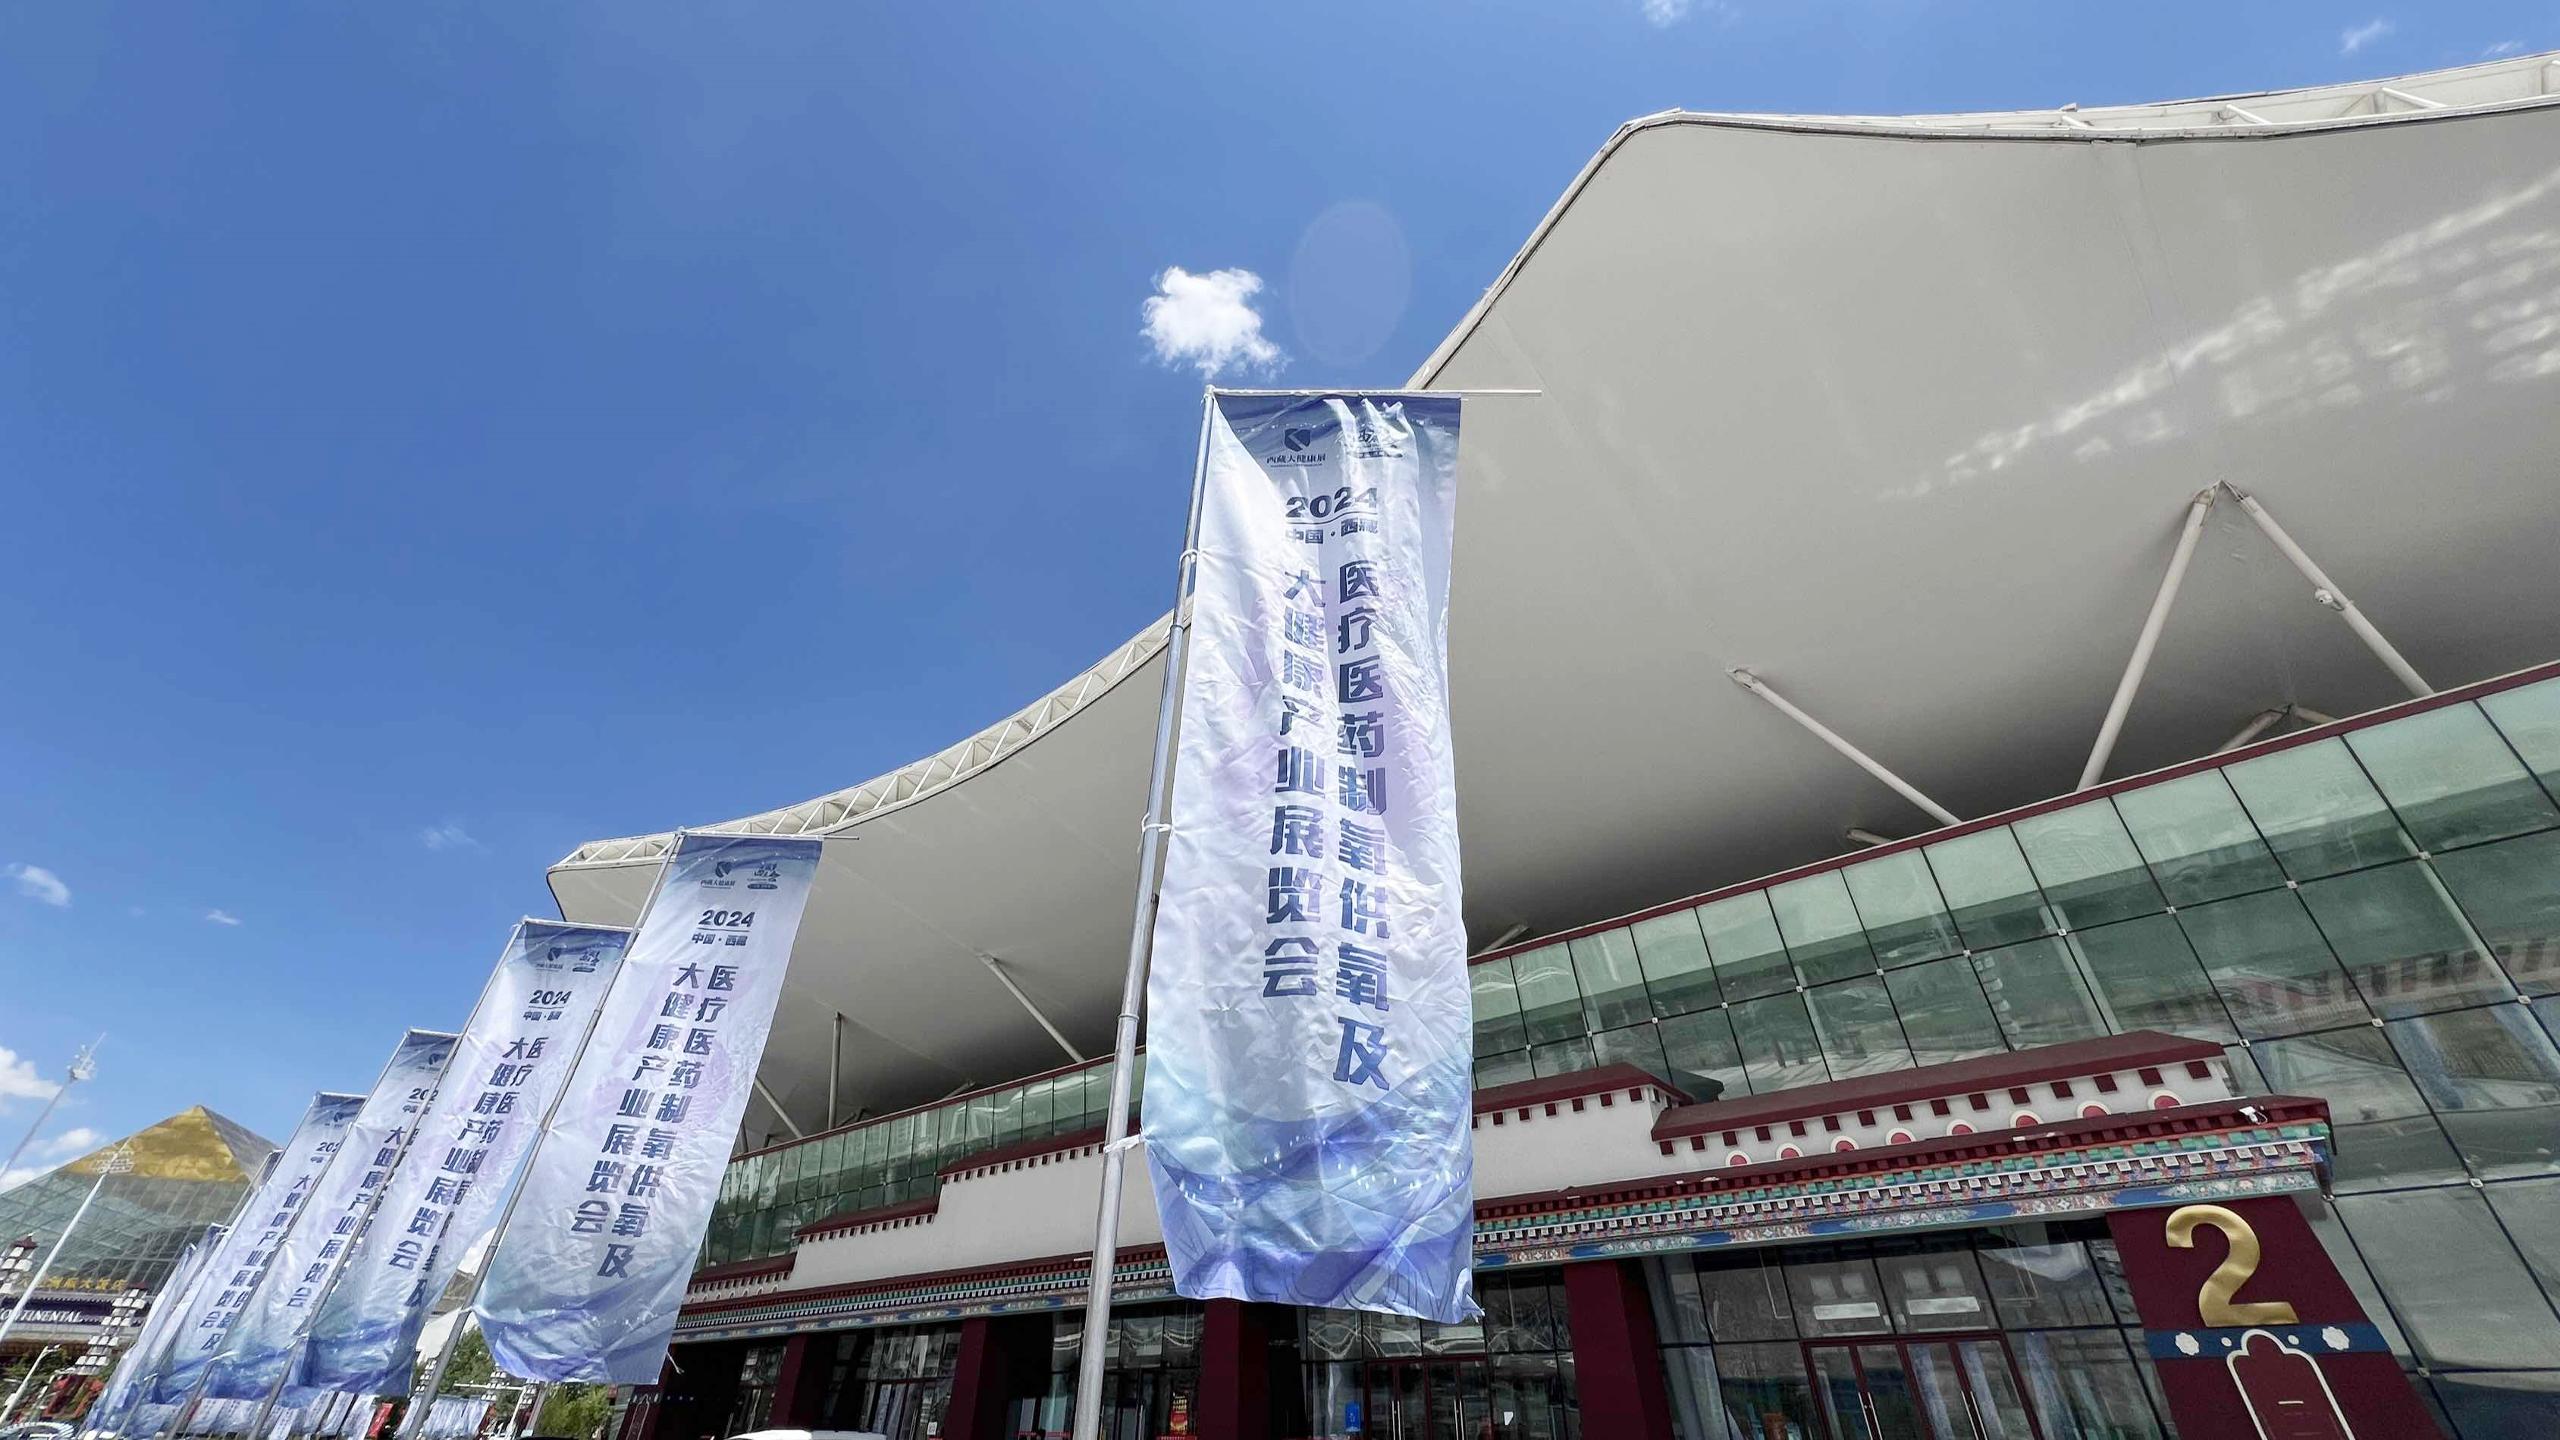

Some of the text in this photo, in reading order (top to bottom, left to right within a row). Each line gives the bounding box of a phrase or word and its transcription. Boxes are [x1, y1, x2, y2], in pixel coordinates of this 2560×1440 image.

[1286, 487, 1378, 518] 2024
[1263, 569, 1327, 997] 大健康产业展览会
[1333, 559, 1390, 1091] 医疗医药制氧供氧及
[692, 932, 748, 947] 中国·西藏
[698, 909, 755, 928] 2024
[529, 989, 573, 1006] 2024
[570, 962, 704, 1234] 大健康产业展览会
[597, 964, 739, 1279] 医疗医药制氧供氧及
[2166, 1204, 2299, 1328] 2
